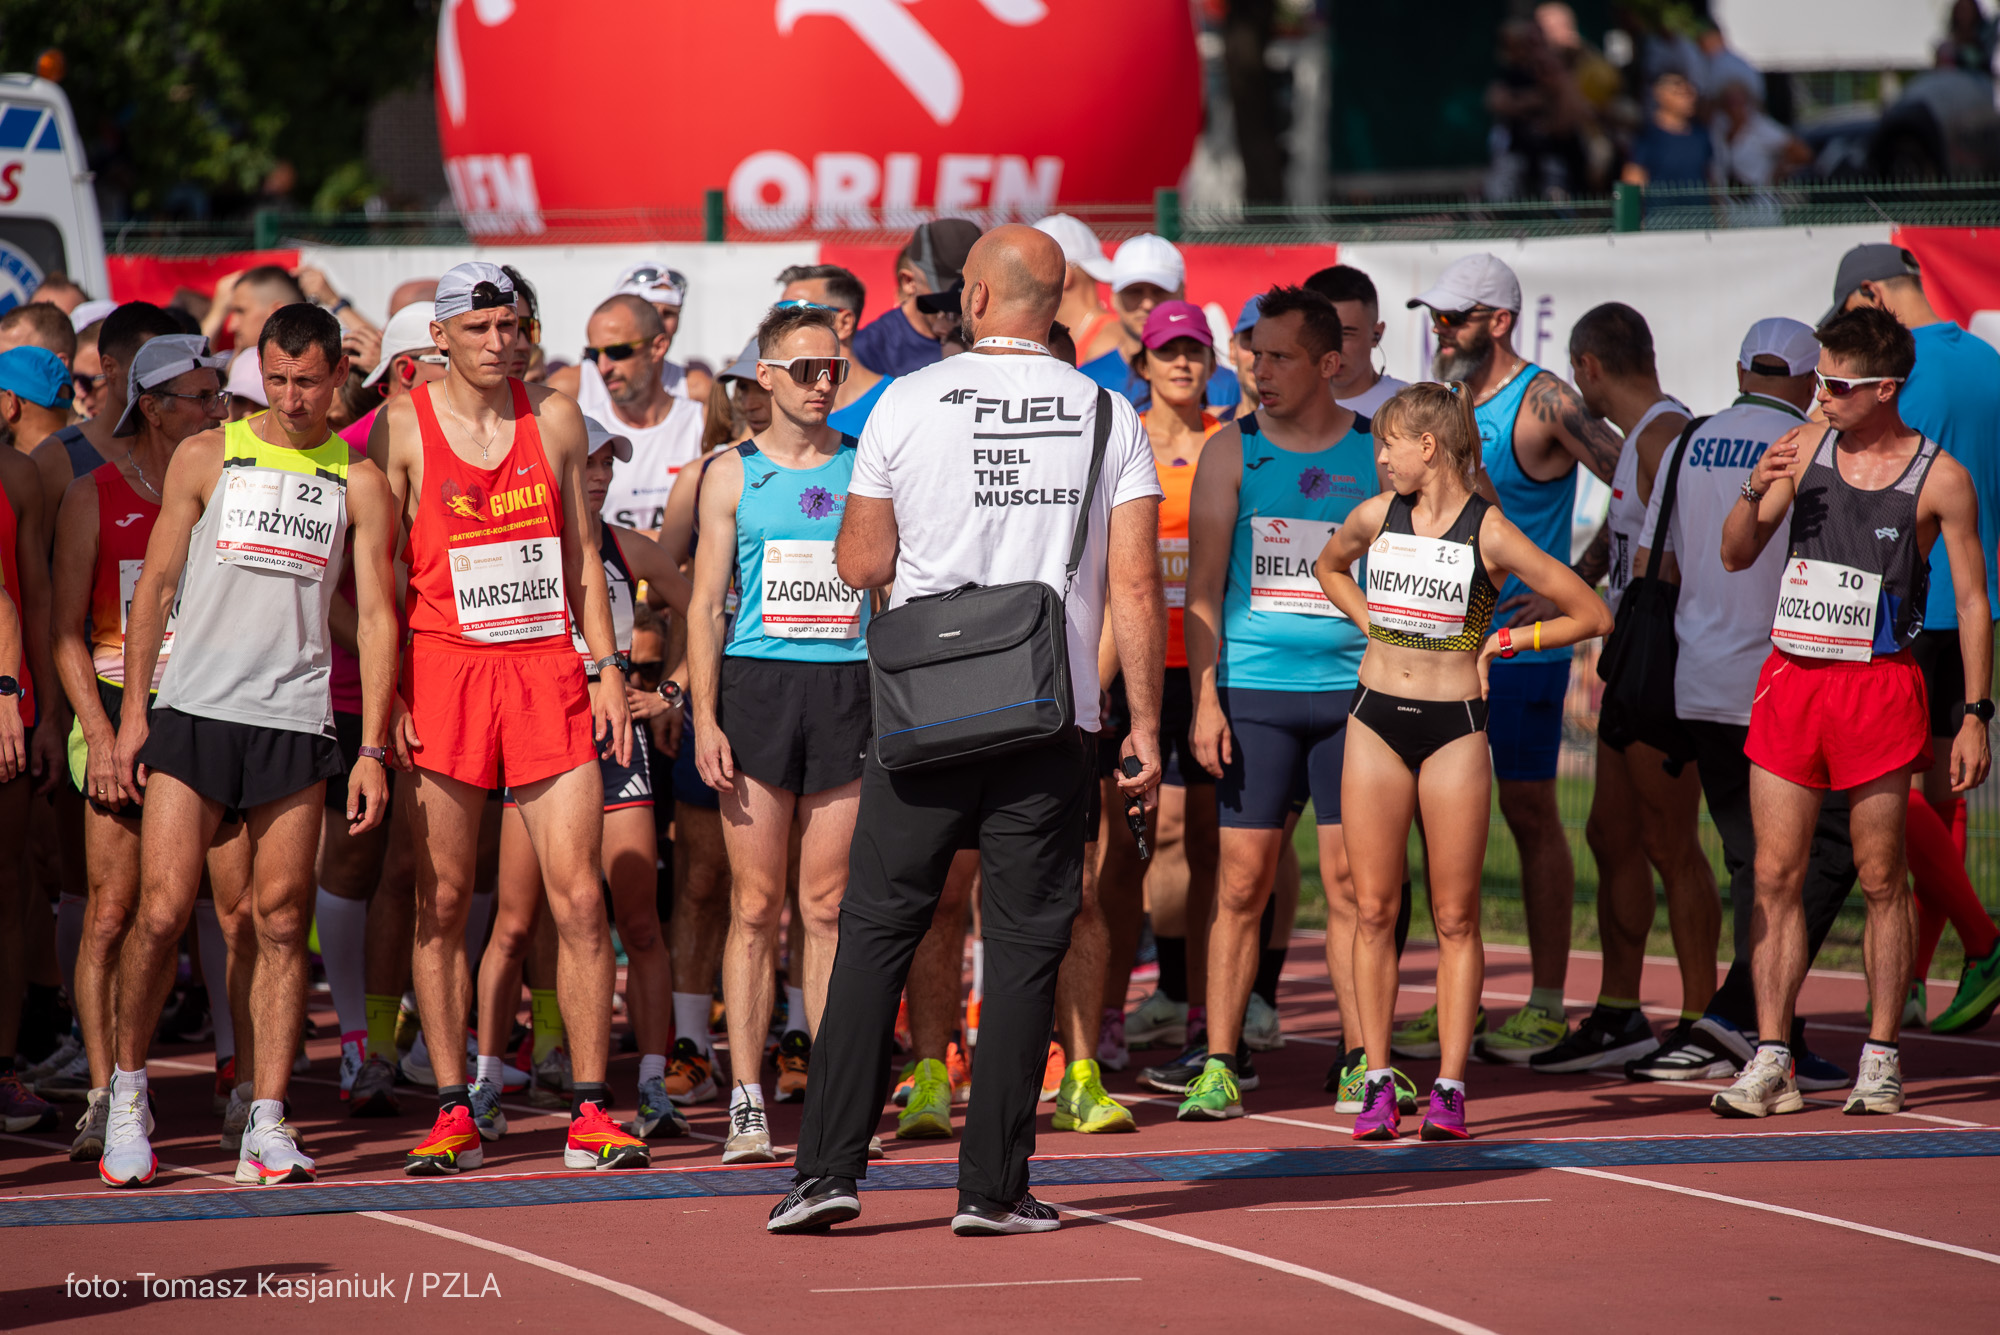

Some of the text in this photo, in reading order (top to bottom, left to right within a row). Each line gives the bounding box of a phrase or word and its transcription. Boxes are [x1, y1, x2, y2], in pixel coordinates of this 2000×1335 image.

[728, 150, 1064, 231] ORLEN
[939, 388, 1082, 423] 4F FUEL
[973, 449, 1031, 465] FUEL
[1689, 437, 1768, 472] SĘDZIA
[974, 470, 1019, 486] THE
[296, 483, 323, 505] 22
[489, 483, 547, 518] GUKLA
[974, 488, 1080, 507] MUSCLES
[225, 507, 332, 545] STARŻYŃSKI
[1263, 536, 1290, 544] ORLEN
[243, 554, 303, 569] GRUDZIĄDZ 2023
[520, 543, 543, 563] 15
[1369, 568, 1464, 603] NIEMYJSKA
[1790, 577, 1808, 586] ORLEN
[1838, 571, 1864, 590] 10
[459, 577, 560, 610] MARSZAŁEK
[1778, 596, 1871, 627] KOZŁOWSKI
[489, 626, 529, 637] GRUDZIĄDZ
[1419, 621, 1436, 629] 2023
